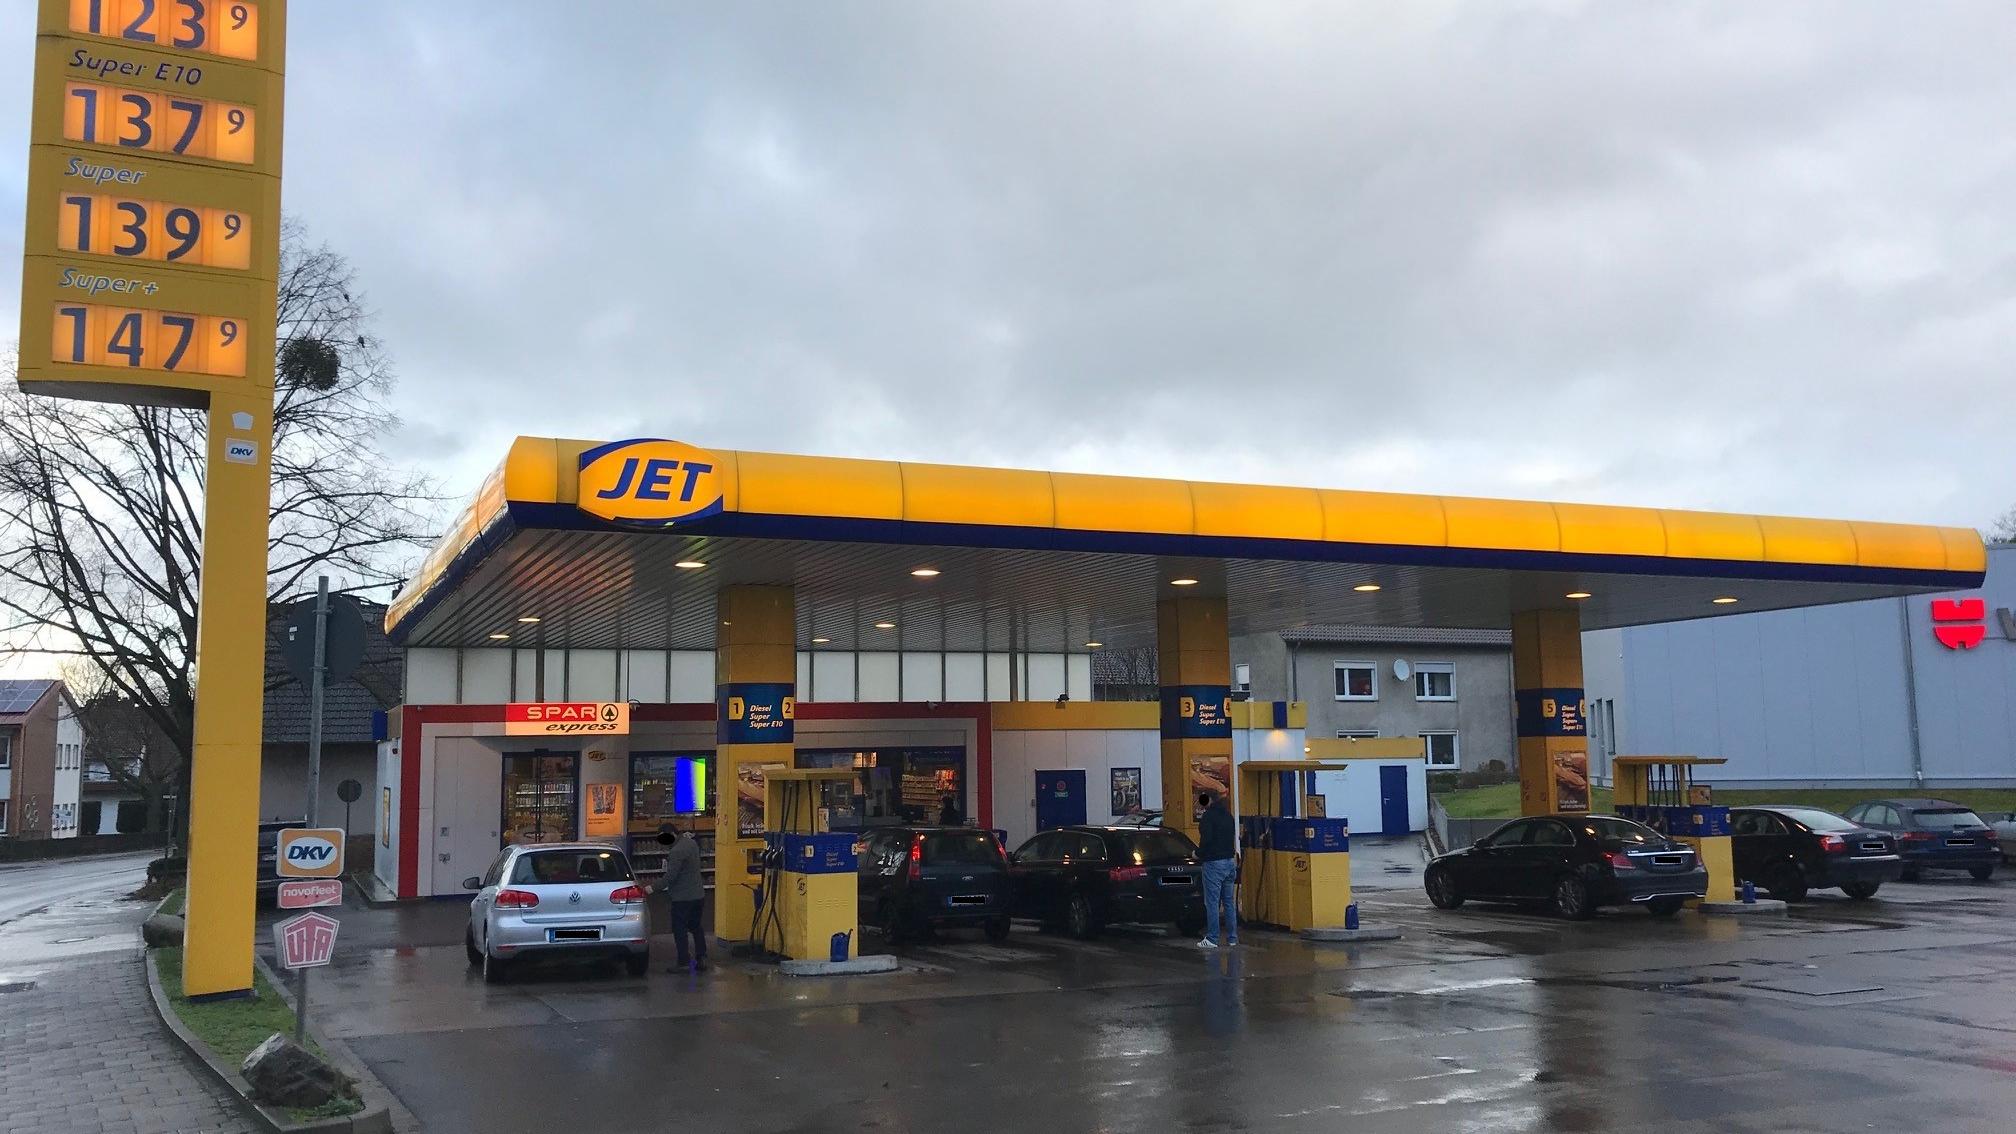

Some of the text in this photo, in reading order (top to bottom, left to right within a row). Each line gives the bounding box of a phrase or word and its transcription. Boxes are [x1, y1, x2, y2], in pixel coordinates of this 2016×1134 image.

[69, 49, 202, 85] Super E10
[64, 157, 146, 185] Super
[231, 447, 253, 456] DKV
[596, 458, 713, 502] JET
[733, 703, 739, 714] 1
[784, 702, 791, 714] 2
[1184, 702, 1191, 712] 3
[1548, 704, 1553, 713] 5
[527, 706, 596, 720] SPAR
[749, 713, 771, 721] Super
[545, 722, 619, 733] express
[749, 720, 770, 729] Super
[288, 845, 333, 861] DKV
[283, 885, 337, 897] novofleet
